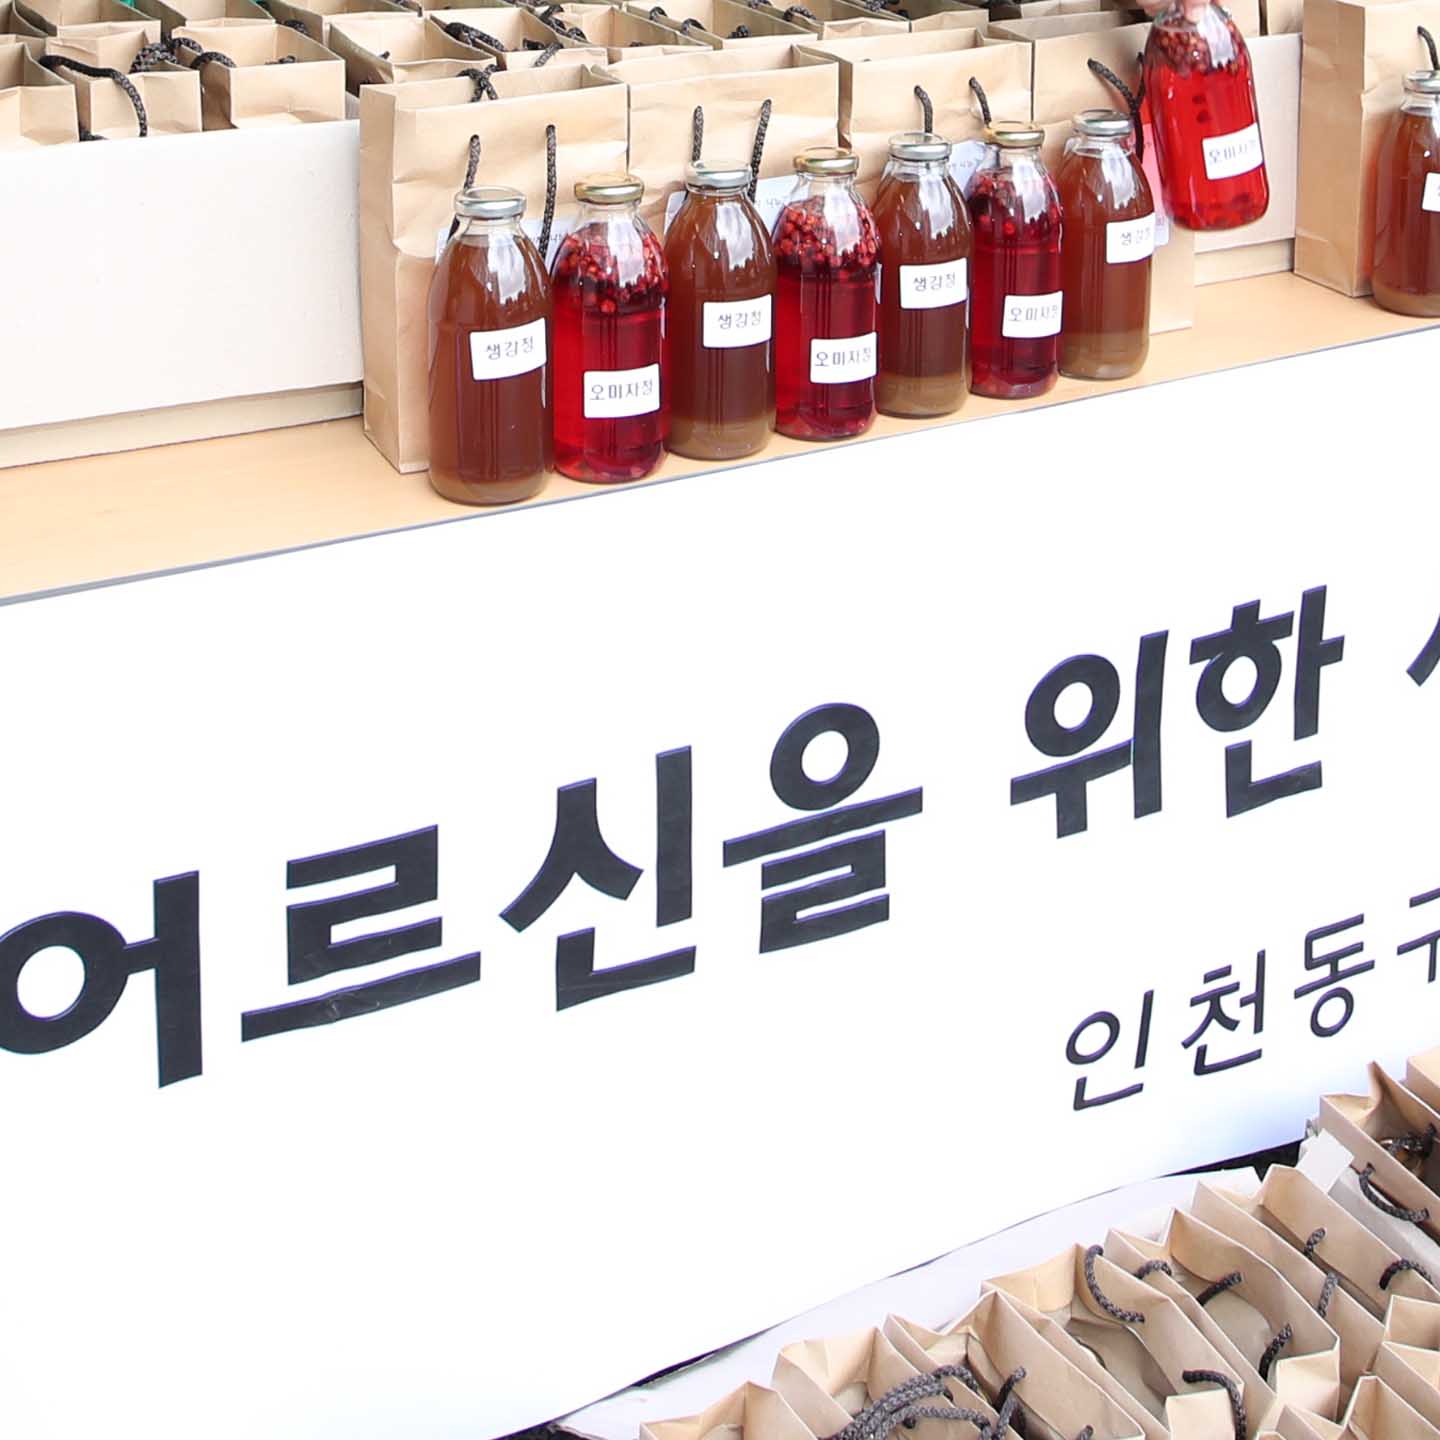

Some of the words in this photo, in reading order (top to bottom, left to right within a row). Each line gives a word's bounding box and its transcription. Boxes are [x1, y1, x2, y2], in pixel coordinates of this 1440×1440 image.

[913, 272, 957, 293] 생강청
[716, 308, 763, 331] 생강청
[484, 334, 535, 361] 생강청
[814, 346, 873, 368] 오미자청
[589, 378, 655, 402] 오미자청
[1009, 584, 1346, 840] 위한
